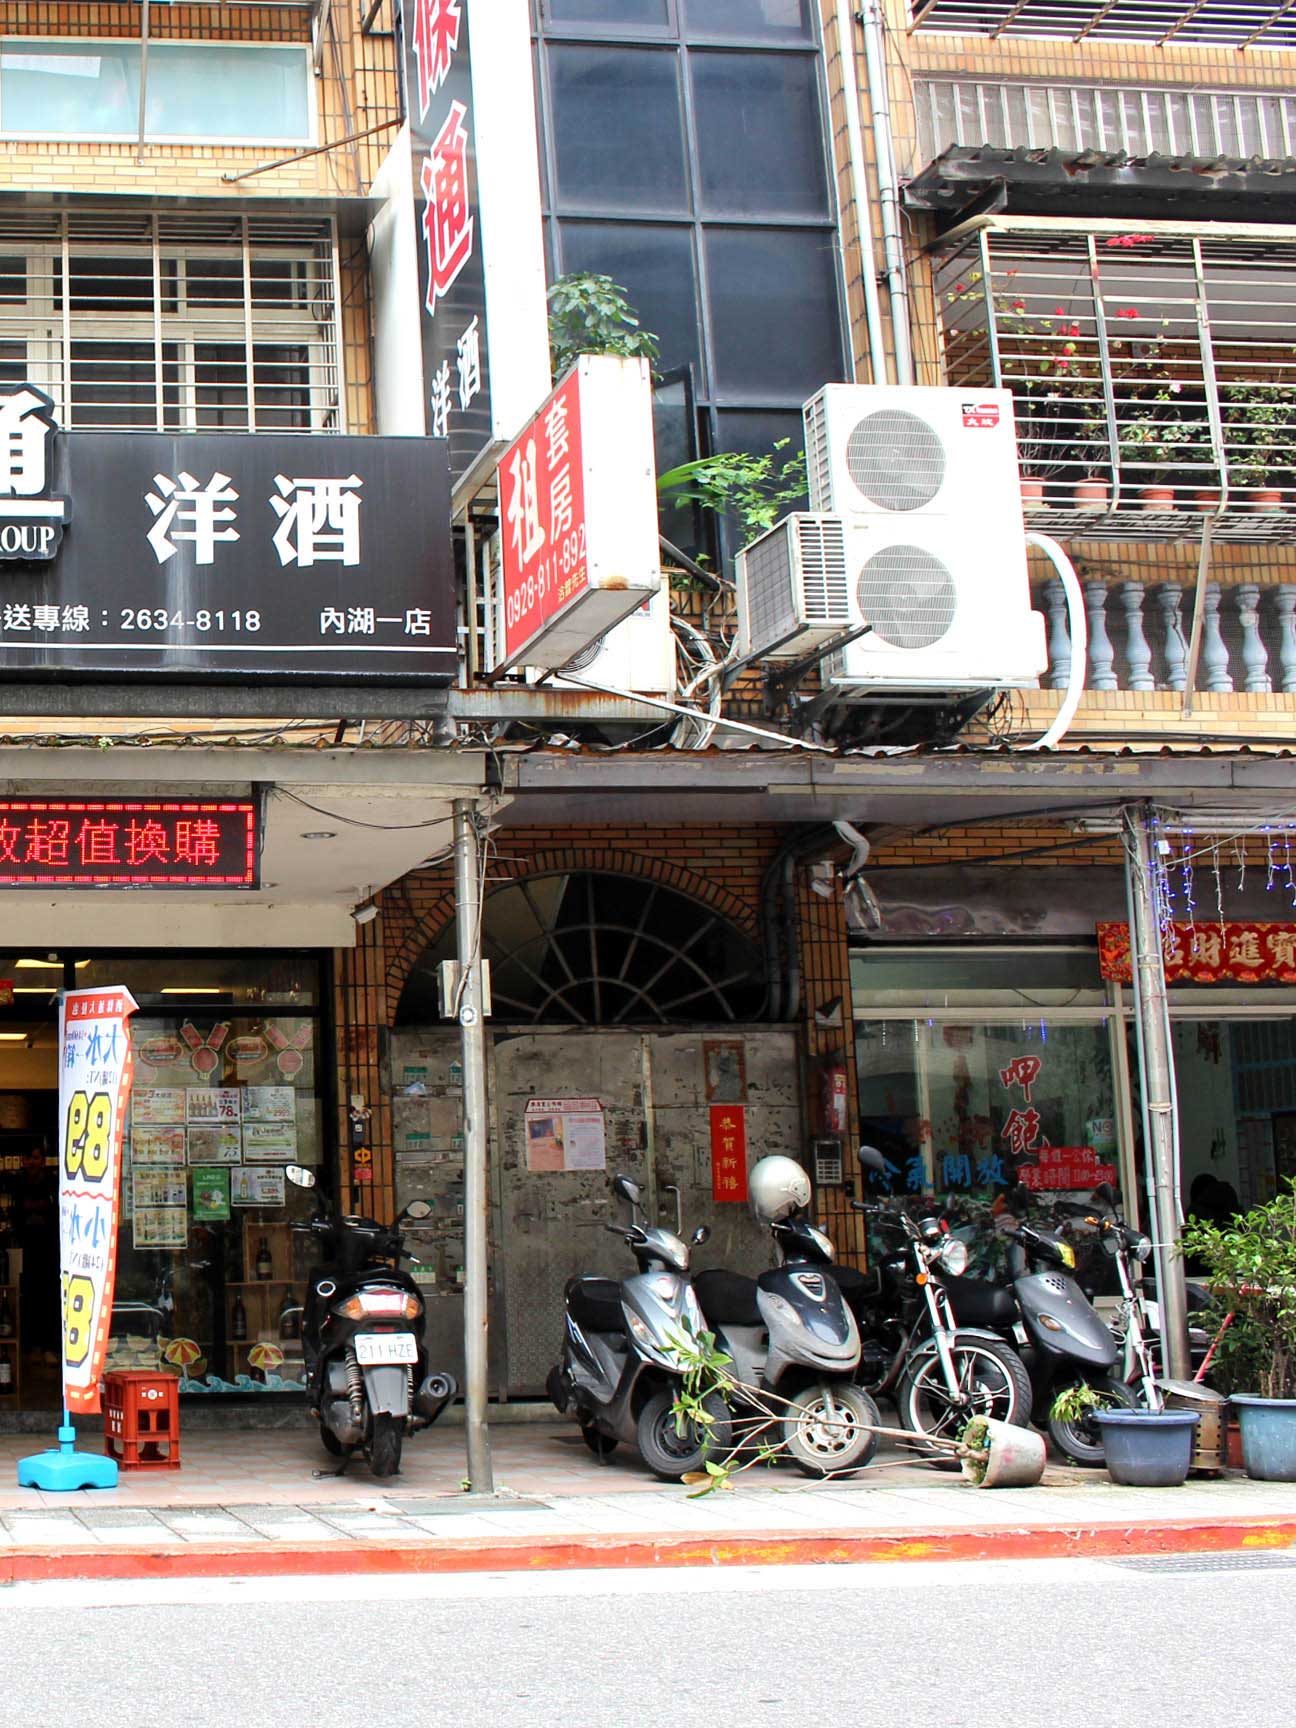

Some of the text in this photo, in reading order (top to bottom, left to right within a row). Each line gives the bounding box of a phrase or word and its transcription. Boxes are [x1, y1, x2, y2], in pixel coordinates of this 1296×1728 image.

[144, 471, 364, 567] 洋酒
[507, 438, 546, 573] 租
[545, 394, 573, 545] 套房
[507, 522, 587, 630] 0928-811-892
